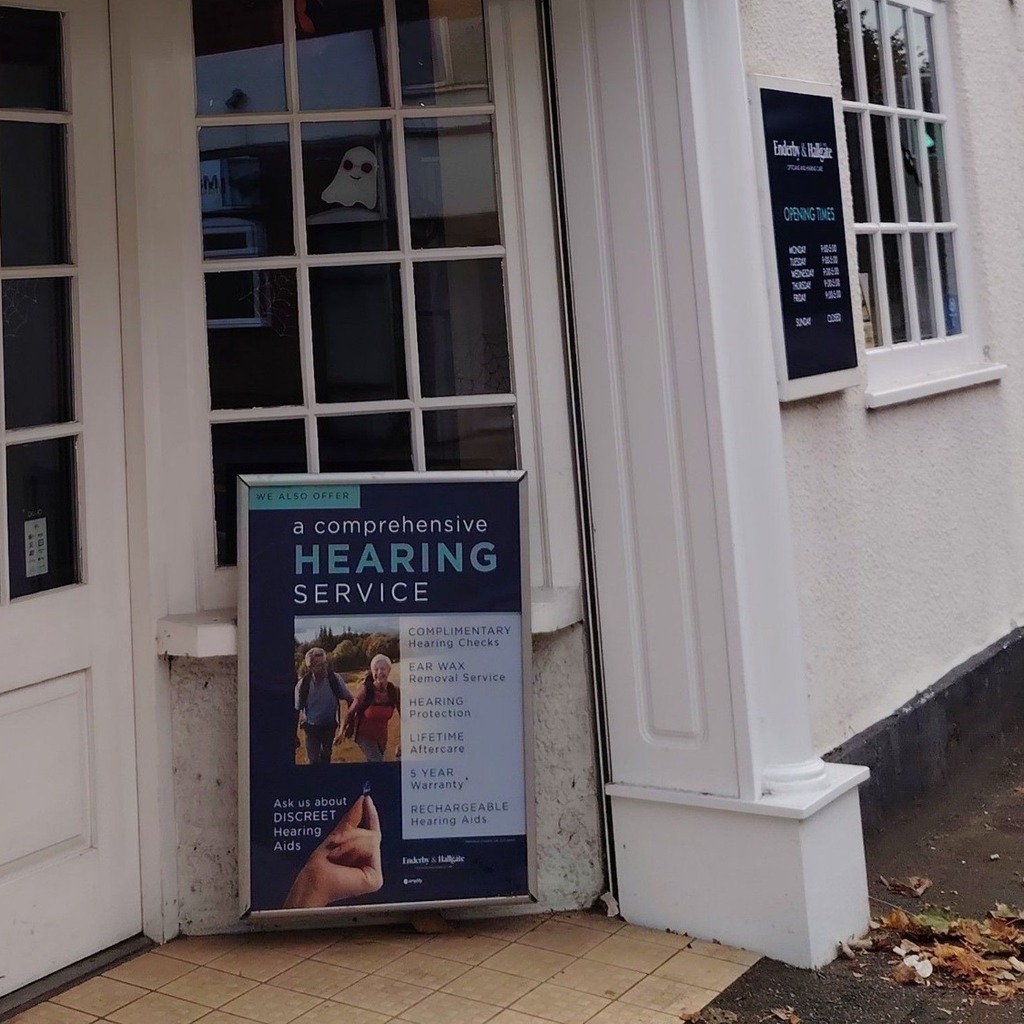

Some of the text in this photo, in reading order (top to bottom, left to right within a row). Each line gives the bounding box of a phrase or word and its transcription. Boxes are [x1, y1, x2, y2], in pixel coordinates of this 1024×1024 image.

[784, 207, 835, 221] OPENING TIMES
[256, 491, 350, 501] WE ALSO OFFER
[293, 515, 488, 537] a comprehensive
[295, 542, 498, 575] HEARING
[294, 581, 429, 604] SERVICE
[408, 626, 512, 637] COMPLIMENTARY
[408, 637, 500, 649] Hearing Checks
[409, 662, 466, 672] EAR WAX
[409, 672, 506, 683] Removal Service
[409, 697, 464, 707] HEARING
[409, 708, 471, 718] Protection
[410, 732, 464, 743] LIFETIME
[410, 743, 465, 754] Aftercare
[410, 768, 454, 778] 5 YEAR
[273, 796, 347, 808] Ask us about
[411, 802, 509, 814] RECHARGEABLE
[273, 810, 337, 823] DISCREET
[411, 814, 487, 827] Hearing Aids
[273, 826, 322, 839] Hearing
[273, 840, 301, 851] Aids
